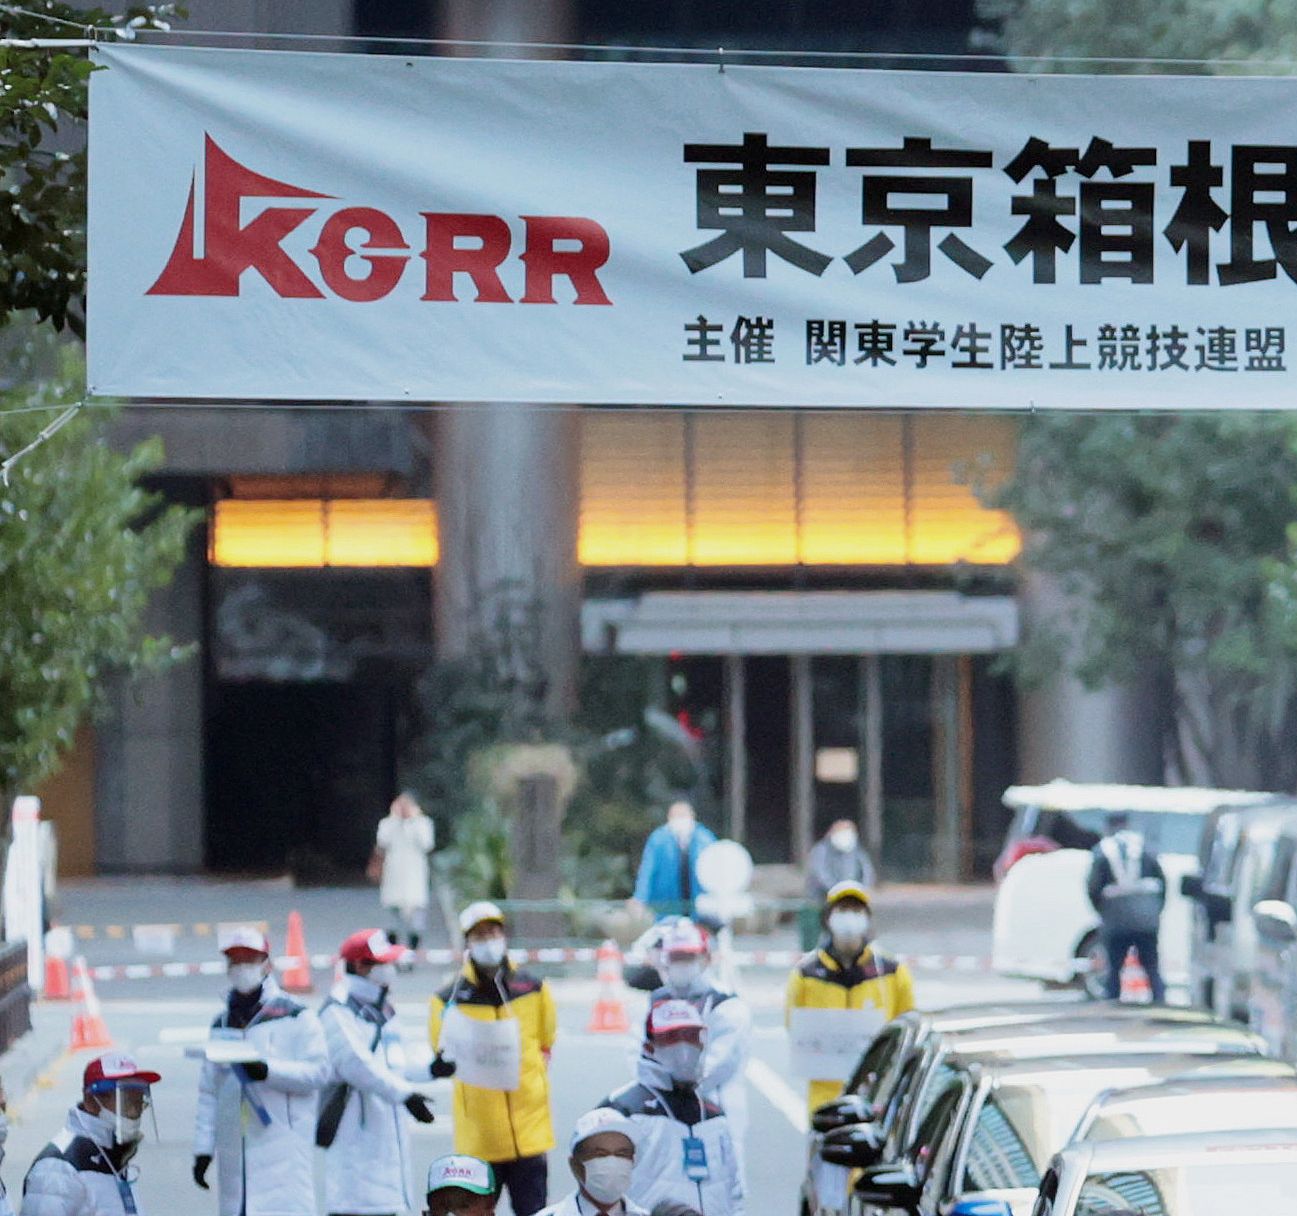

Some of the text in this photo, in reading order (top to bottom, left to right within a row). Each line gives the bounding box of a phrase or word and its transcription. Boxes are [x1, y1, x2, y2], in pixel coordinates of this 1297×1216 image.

[144, 130, 613, 305] KGRR
[683, 315, 775, 363] 主催
[806, 320, 1286, 372] 関東学生陸上競技連盟
